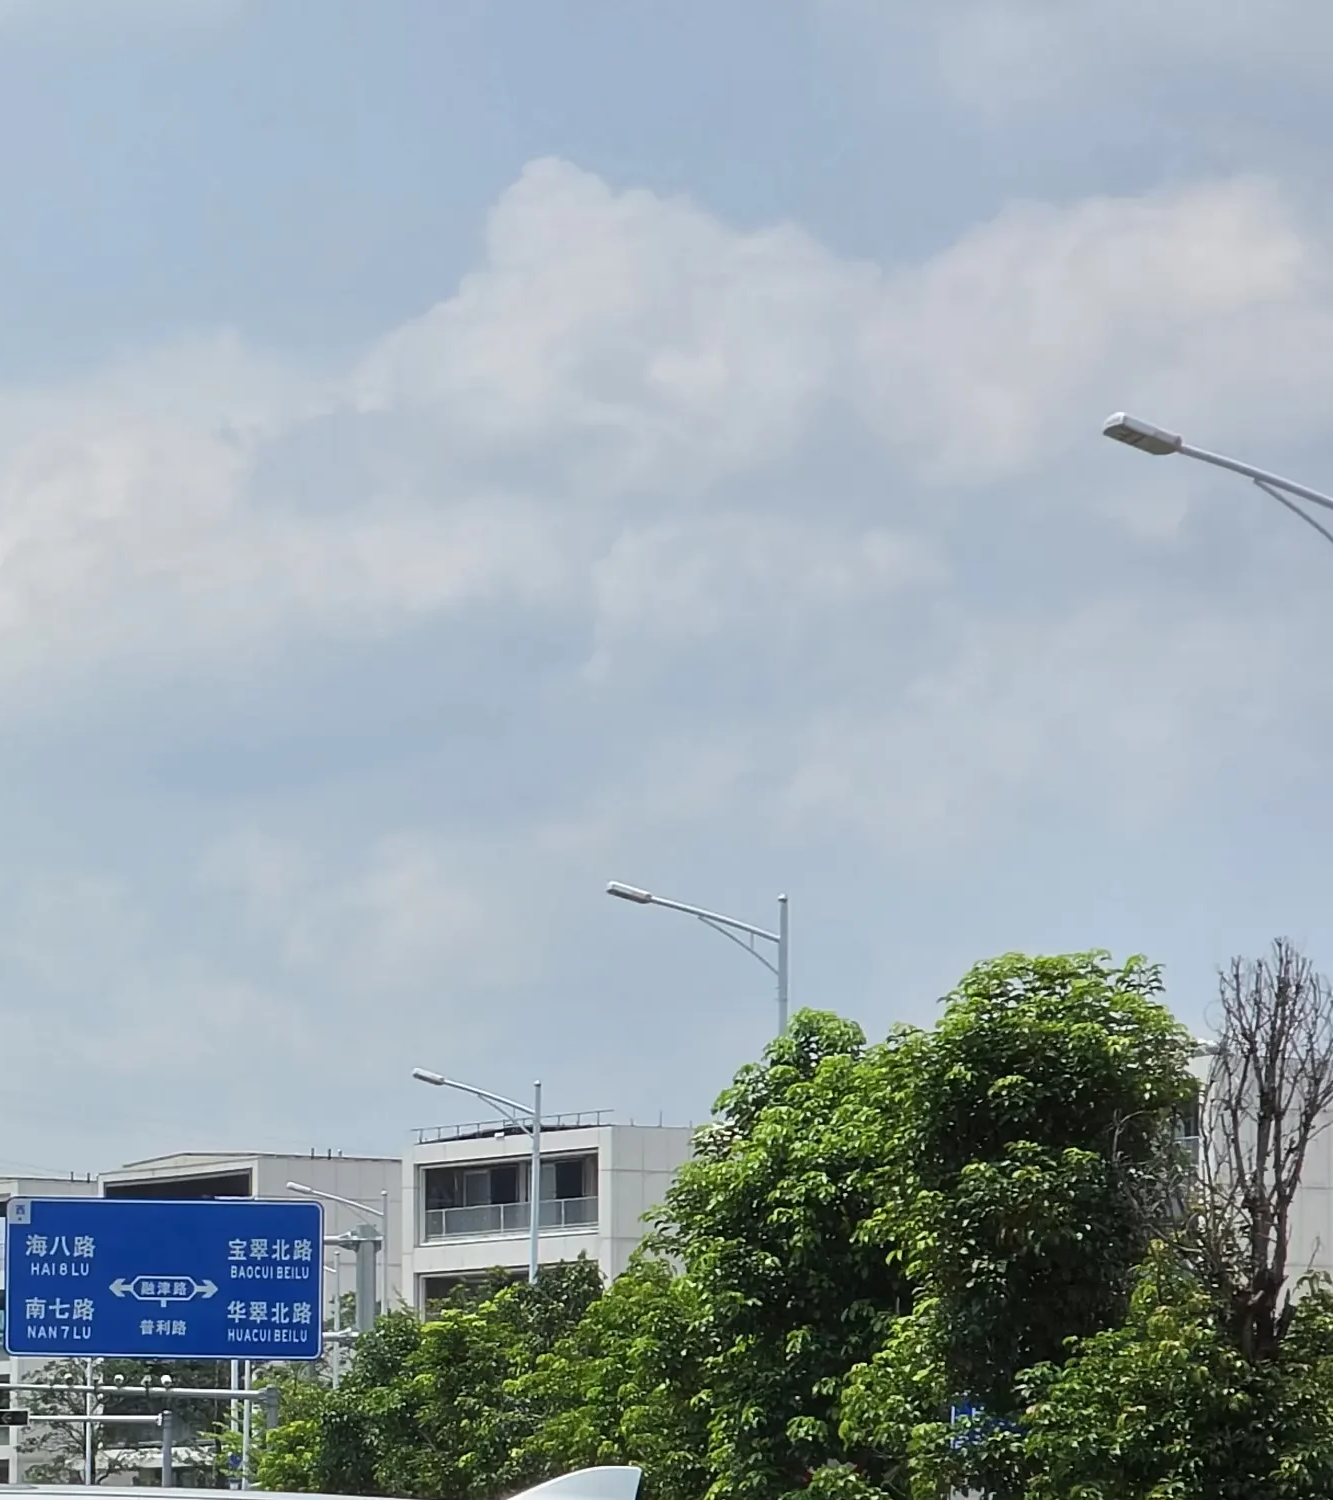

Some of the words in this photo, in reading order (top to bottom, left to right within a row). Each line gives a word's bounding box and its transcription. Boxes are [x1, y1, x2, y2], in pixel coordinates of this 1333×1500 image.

[25, 1234, 96, 1258] 海八路
[228, 1238, 312, 1261] 宝翠北路
[30, 1262, 56, 1276] HAI
[59, 1262, 68, 1276] 8
[72, 1262, 90, 1276] LU
[230, 1265, 273, 1279] BAOCUI
[276, 1265, 309, 1280] BEILU
[25, 1297, 95, 1321] 南七路
[227, 1300, 312, 1324] 华翠北路
[27, 1325, 57, 1339] NAN
[61, 1325, 70, 1339] 7
[73, 1325, 91, 1340] LU
[139, 1319, 187, 1336] 普利路
[227, 1328, 271, 1342] HUACUI
[274, 1329, 308, 1343] BEILU
